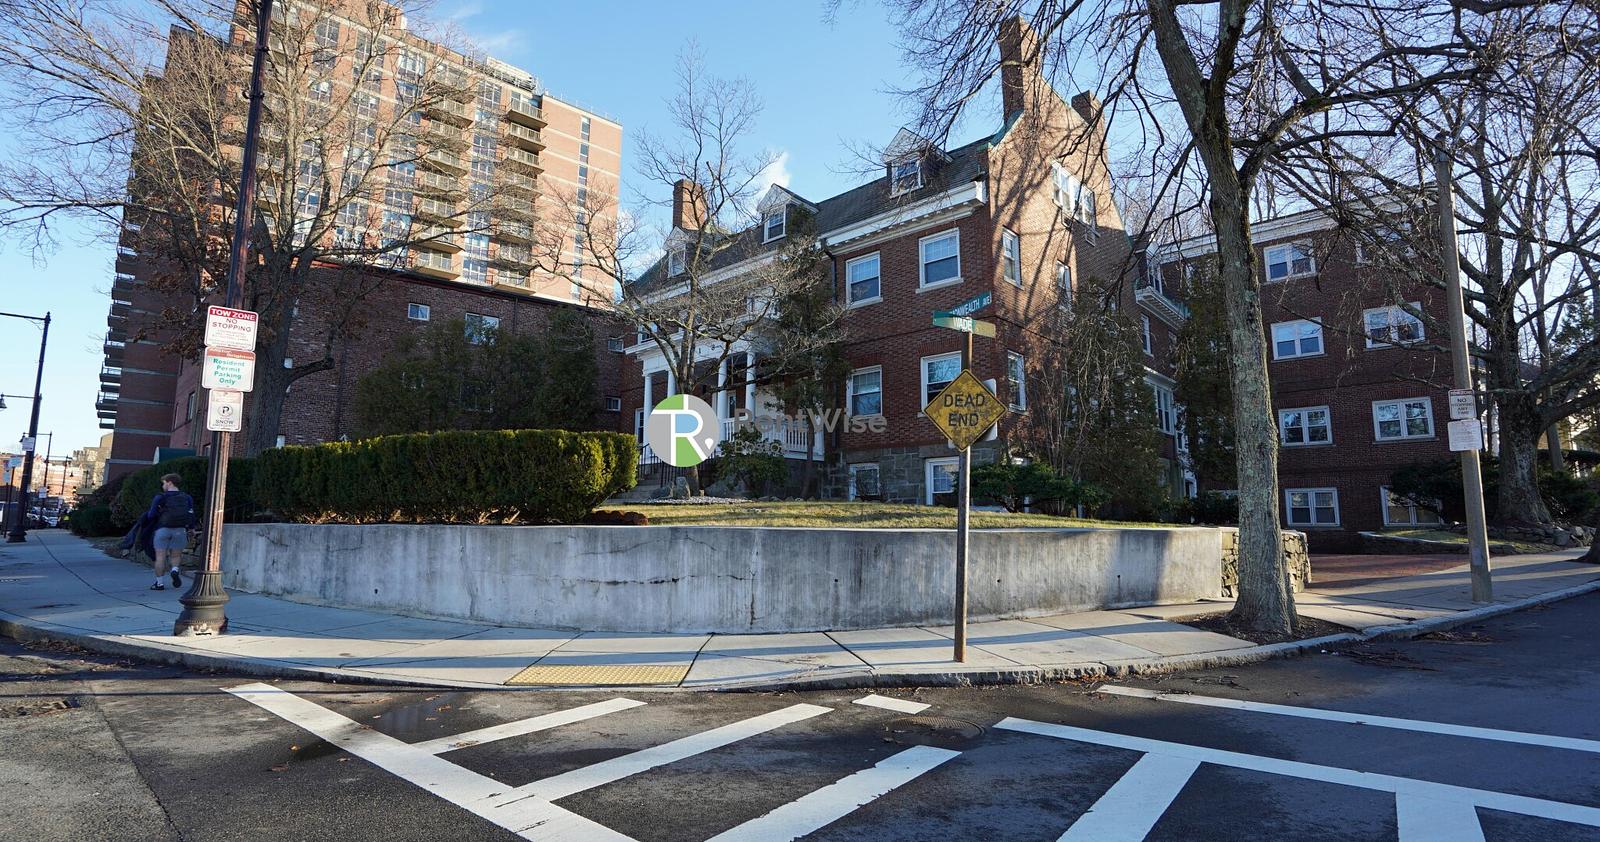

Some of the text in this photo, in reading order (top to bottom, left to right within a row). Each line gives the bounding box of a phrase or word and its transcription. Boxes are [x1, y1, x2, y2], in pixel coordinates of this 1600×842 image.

[211, 308, 256, 321] TOW ZONE
[212, 321, 252, 333] STOPPING
[953, 316, 972, 333] WADE
[213, 358, 245, 367] Resident
[214, 370, 242, 380] Parking
[216, 365, 241, 373] Permit
[219, 377, 236, 385] Only
[944, 393, 985, 408] DEAD
[948, 412, 979, 427] END
